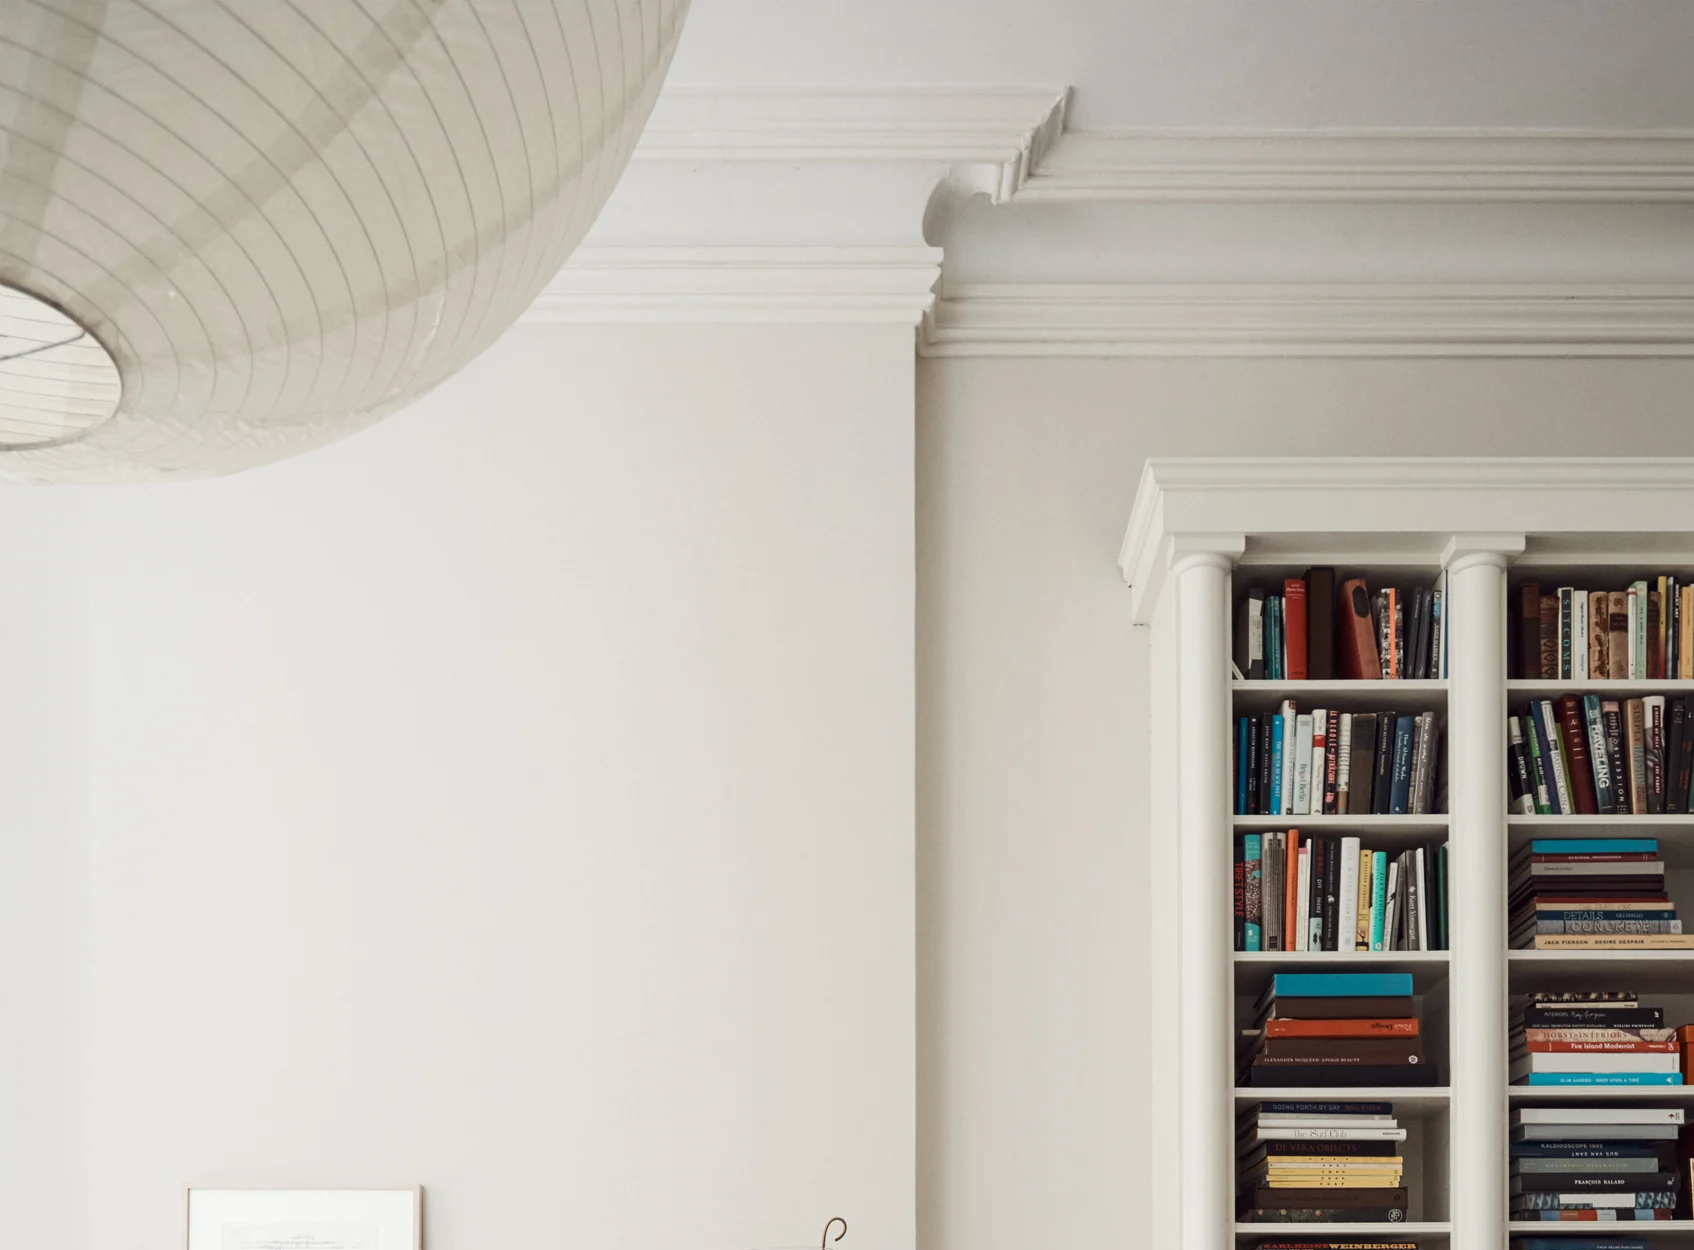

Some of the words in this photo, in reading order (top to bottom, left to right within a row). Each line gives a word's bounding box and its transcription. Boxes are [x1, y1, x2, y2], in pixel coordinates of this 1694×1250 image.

[1563, 599, 1571, 671] SITCOMS
[1633, 704, 1642, 742] SIMPLY
[1299, 763, 1307, 782] Brigid
[1518, 756, 1527, 779] DROWN
[1552, 752, 1563, 784] RAISING
[1613, 738, 1624, 802] OBSESSION
[1634, 745, 1645, 784] HALSTON
[1234, 862, 1244, 886] TIBET
[1234, 888, 1244, 917] STYLE
[1564, 912, 1604, 920] DETAILS
[1572, 922, 1650, 932] CONCRETE
[1294, 1130, 1306, 1138] The
[1310, 1130, 1326, 1138] Surf
[1329, 1130, 1347, 1138] Club
[1276, 1144, 1286, 1152] DE
[1289, 1144, 1314, 1152] VERA
[1316, 1144, 1356, 1152] OBJECTS
